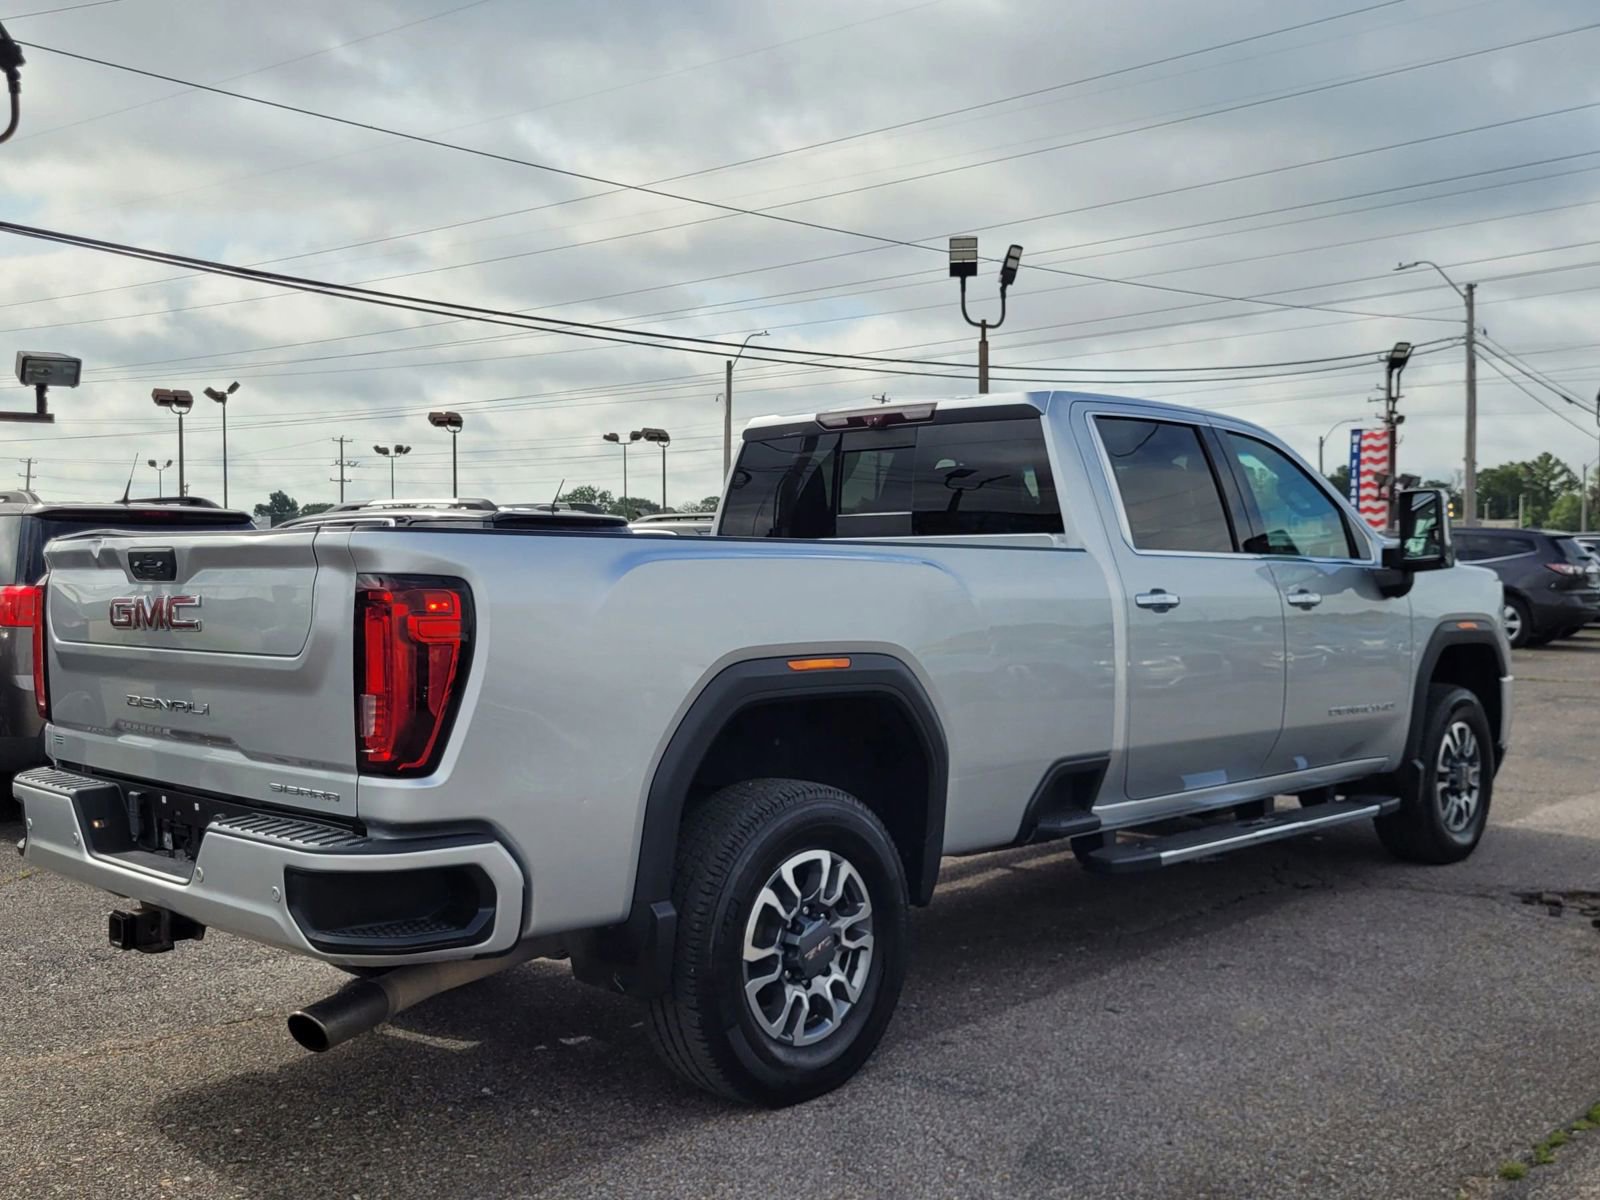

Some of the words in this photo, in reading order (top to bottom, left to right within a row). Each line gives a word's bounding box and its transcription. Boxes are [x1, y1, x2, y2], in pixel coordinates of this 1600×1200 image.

[109, 594, 202, 632] GMC
[126, 694, 210, 715] DENALI
[269, 782, 340, 801] SIERRA
